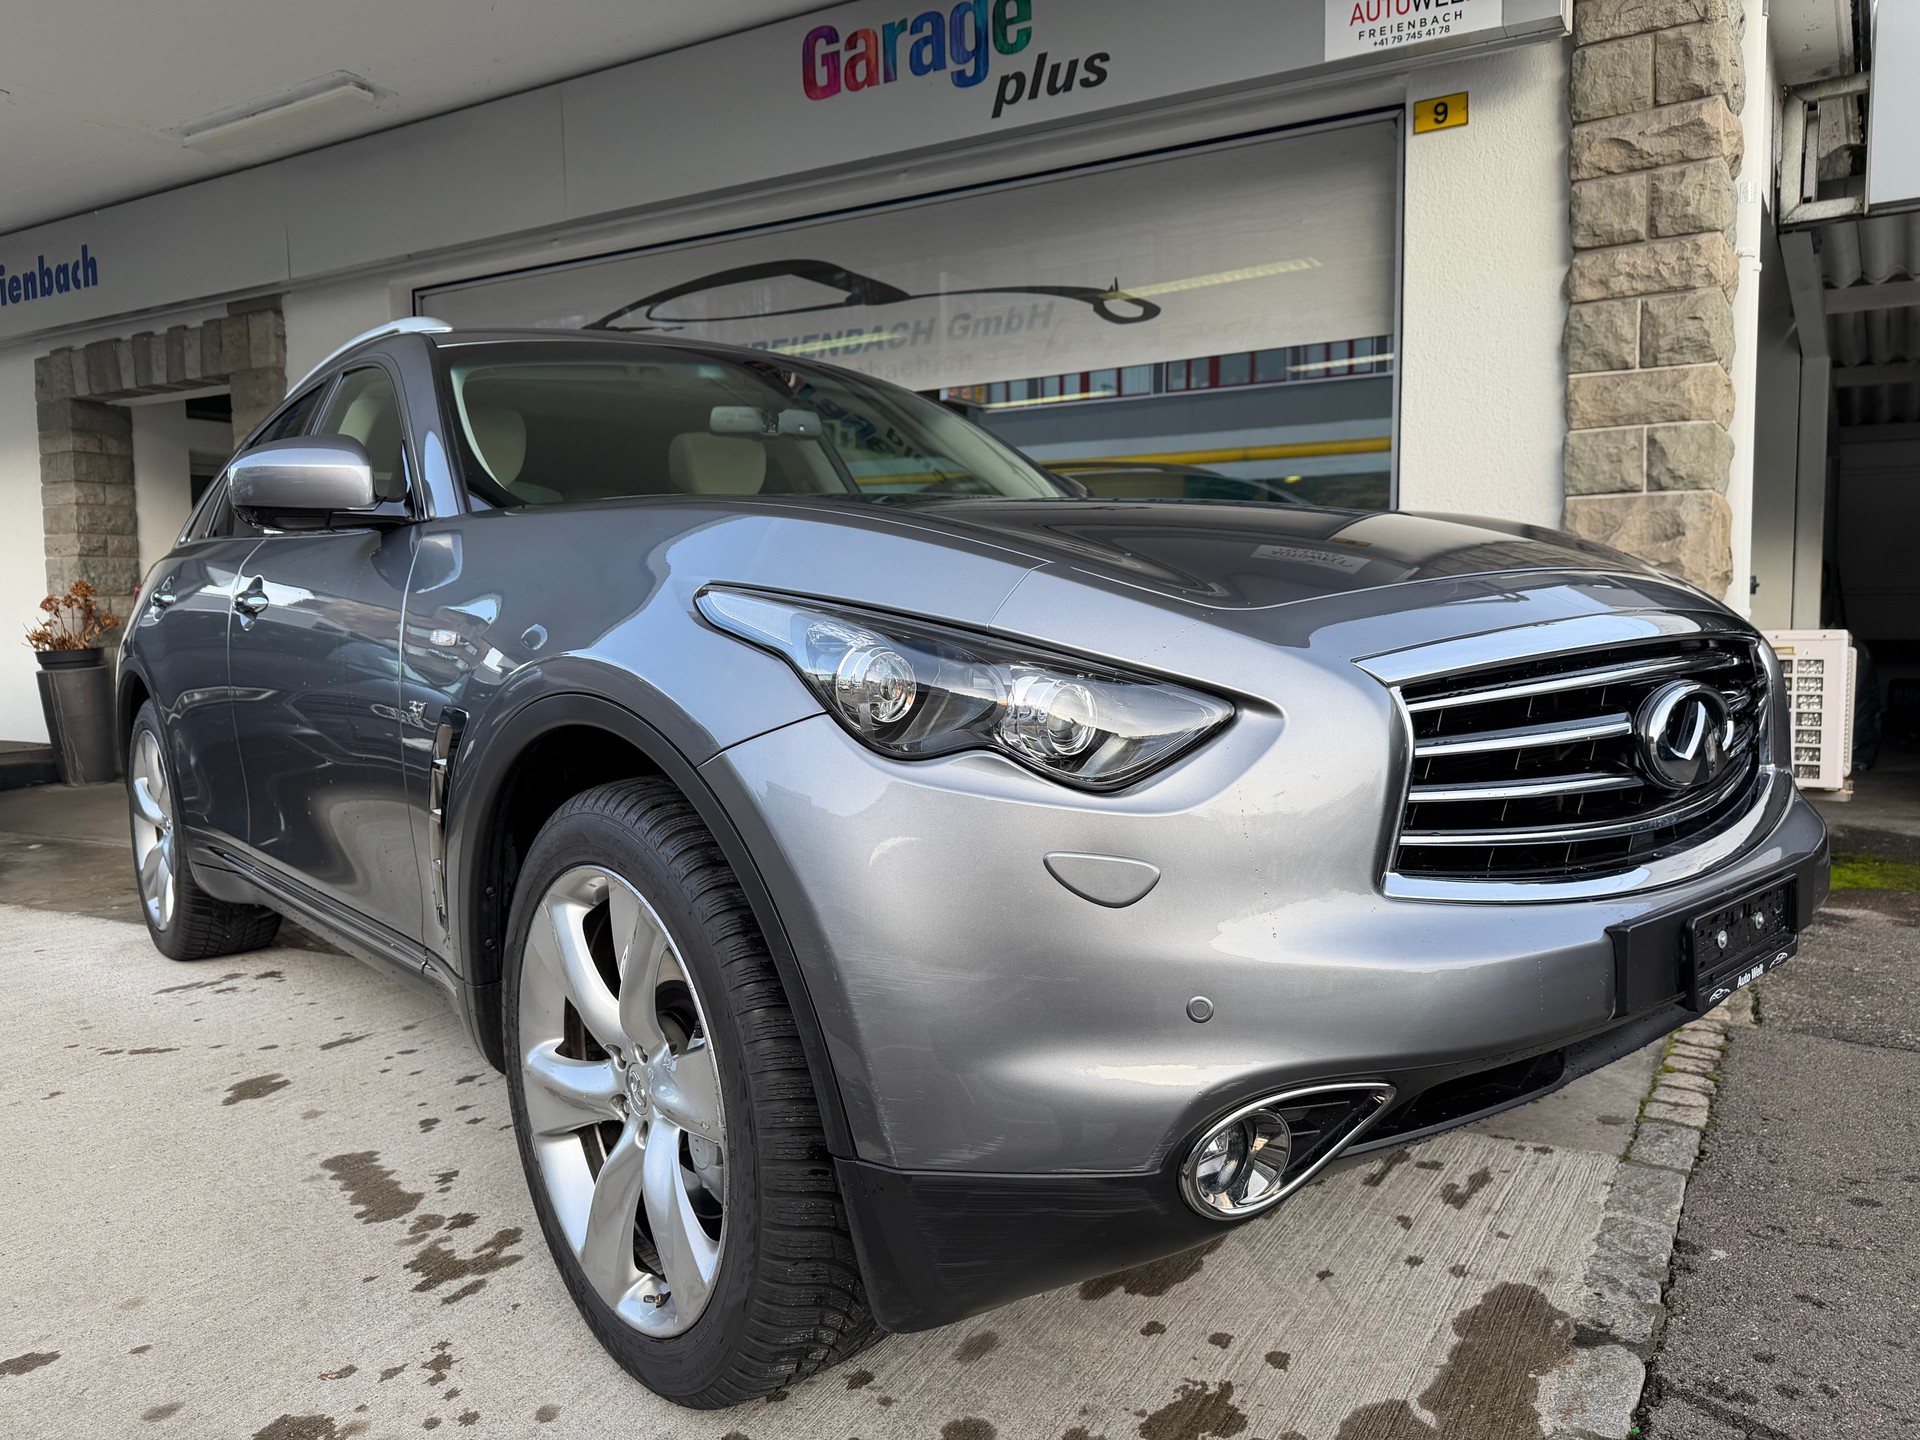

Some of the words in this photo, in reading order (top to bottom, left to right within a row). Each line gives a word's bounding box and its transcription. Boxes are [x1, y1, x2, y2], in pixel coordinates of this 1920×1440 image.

[1358, 9, 1463, 41] FREIENBACH
[1373, 37, 1389, 48] +41
[1391, 34, 1403, 45] 79
[1405, 30, 1423, 42] 745
[1425, 26, 1436, 38] 41
[1438, 24, 1451, 35] 78
[802, 0, 1032, 101] Garage
[991, 51, 1110, 119] plus
[1433, 101, 1449, 125] 9
[947, 301, 1054, 341] GmbH
[1737, 973, 1751, 988] Auto
[1751, 963, 1764, 979] Welt
